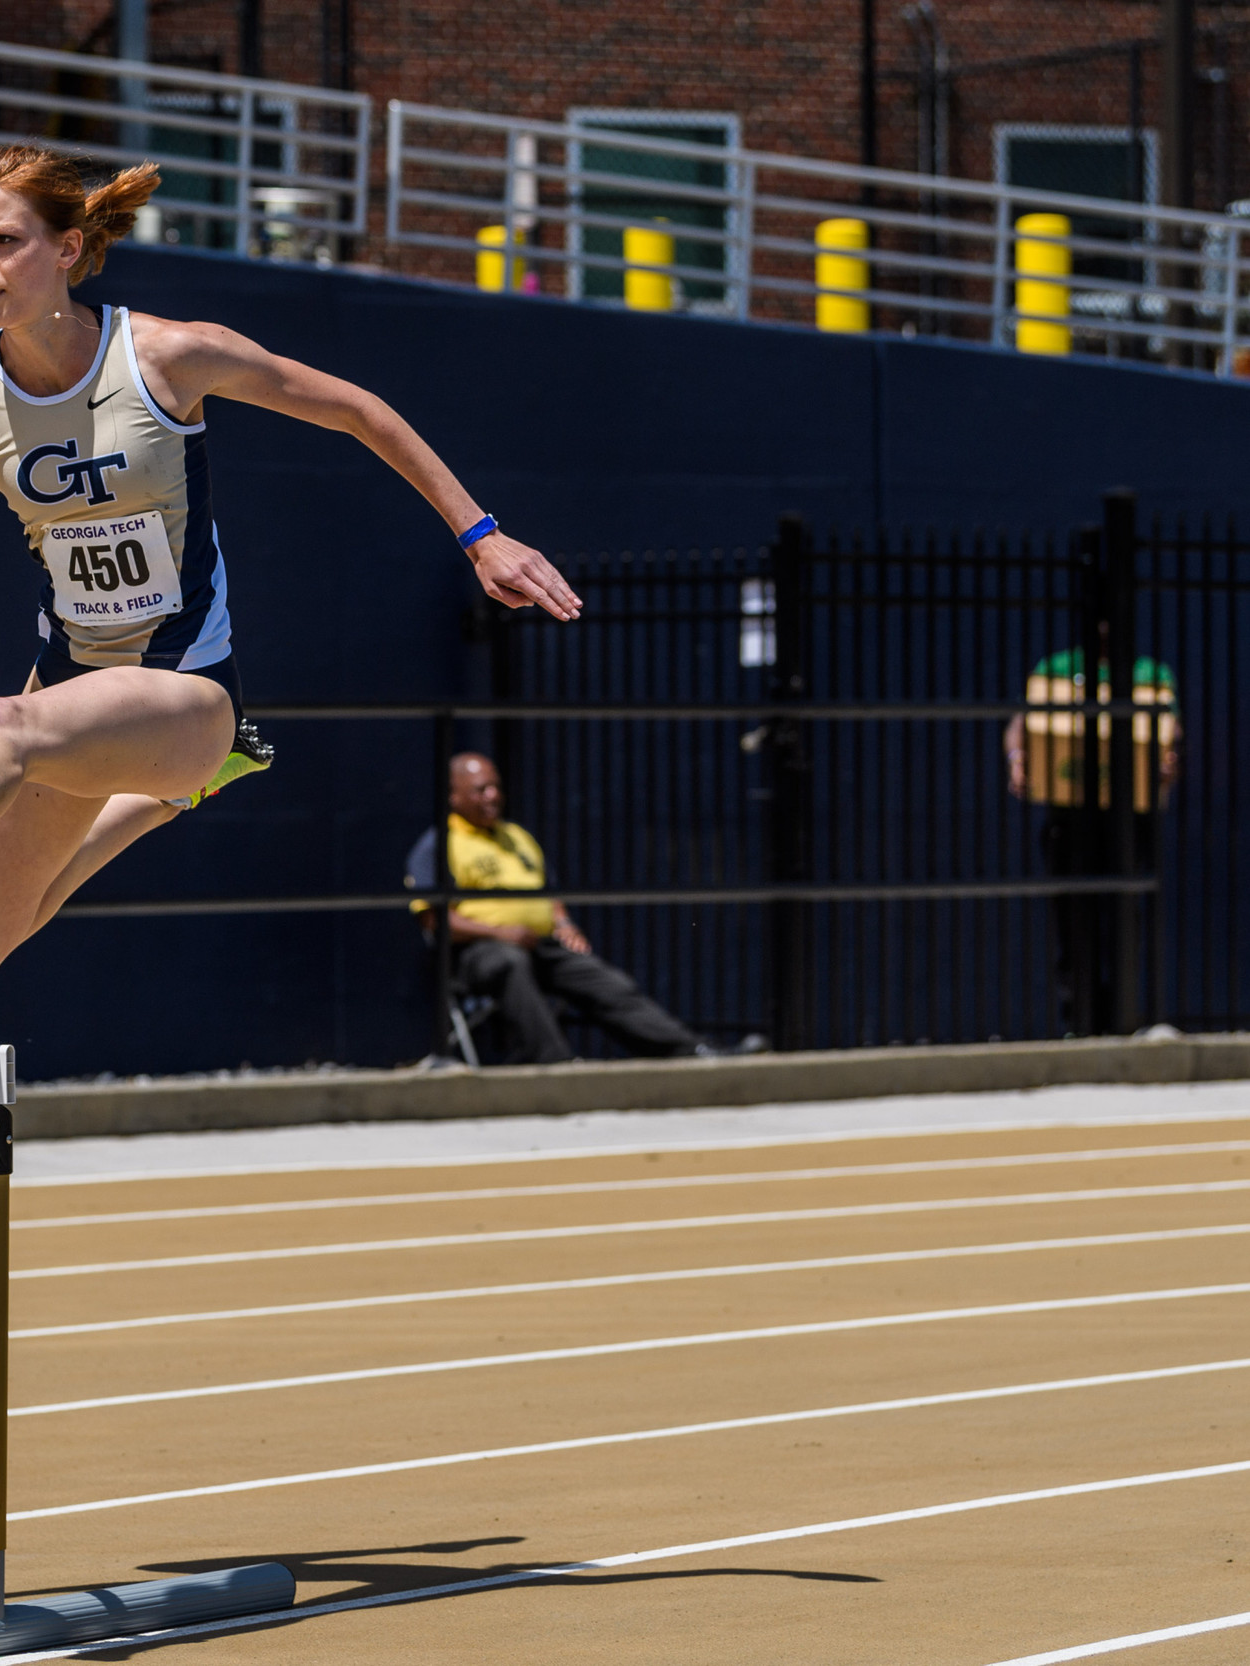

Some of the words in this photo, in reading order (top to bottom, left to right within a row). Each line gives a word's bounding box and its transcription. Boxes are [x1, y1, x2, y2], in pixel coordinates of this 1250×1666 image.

[16, 438, 130, 507] GT
[51, 525, 108, 540] GEORGIA
[110, 518, 146, 535] TECH
[68, 539, 150, 592] 450
[73, 601, 110, 615] TRACK
[113, 602, 124, 614] &
[127, 593, 163, 612] FIELD
